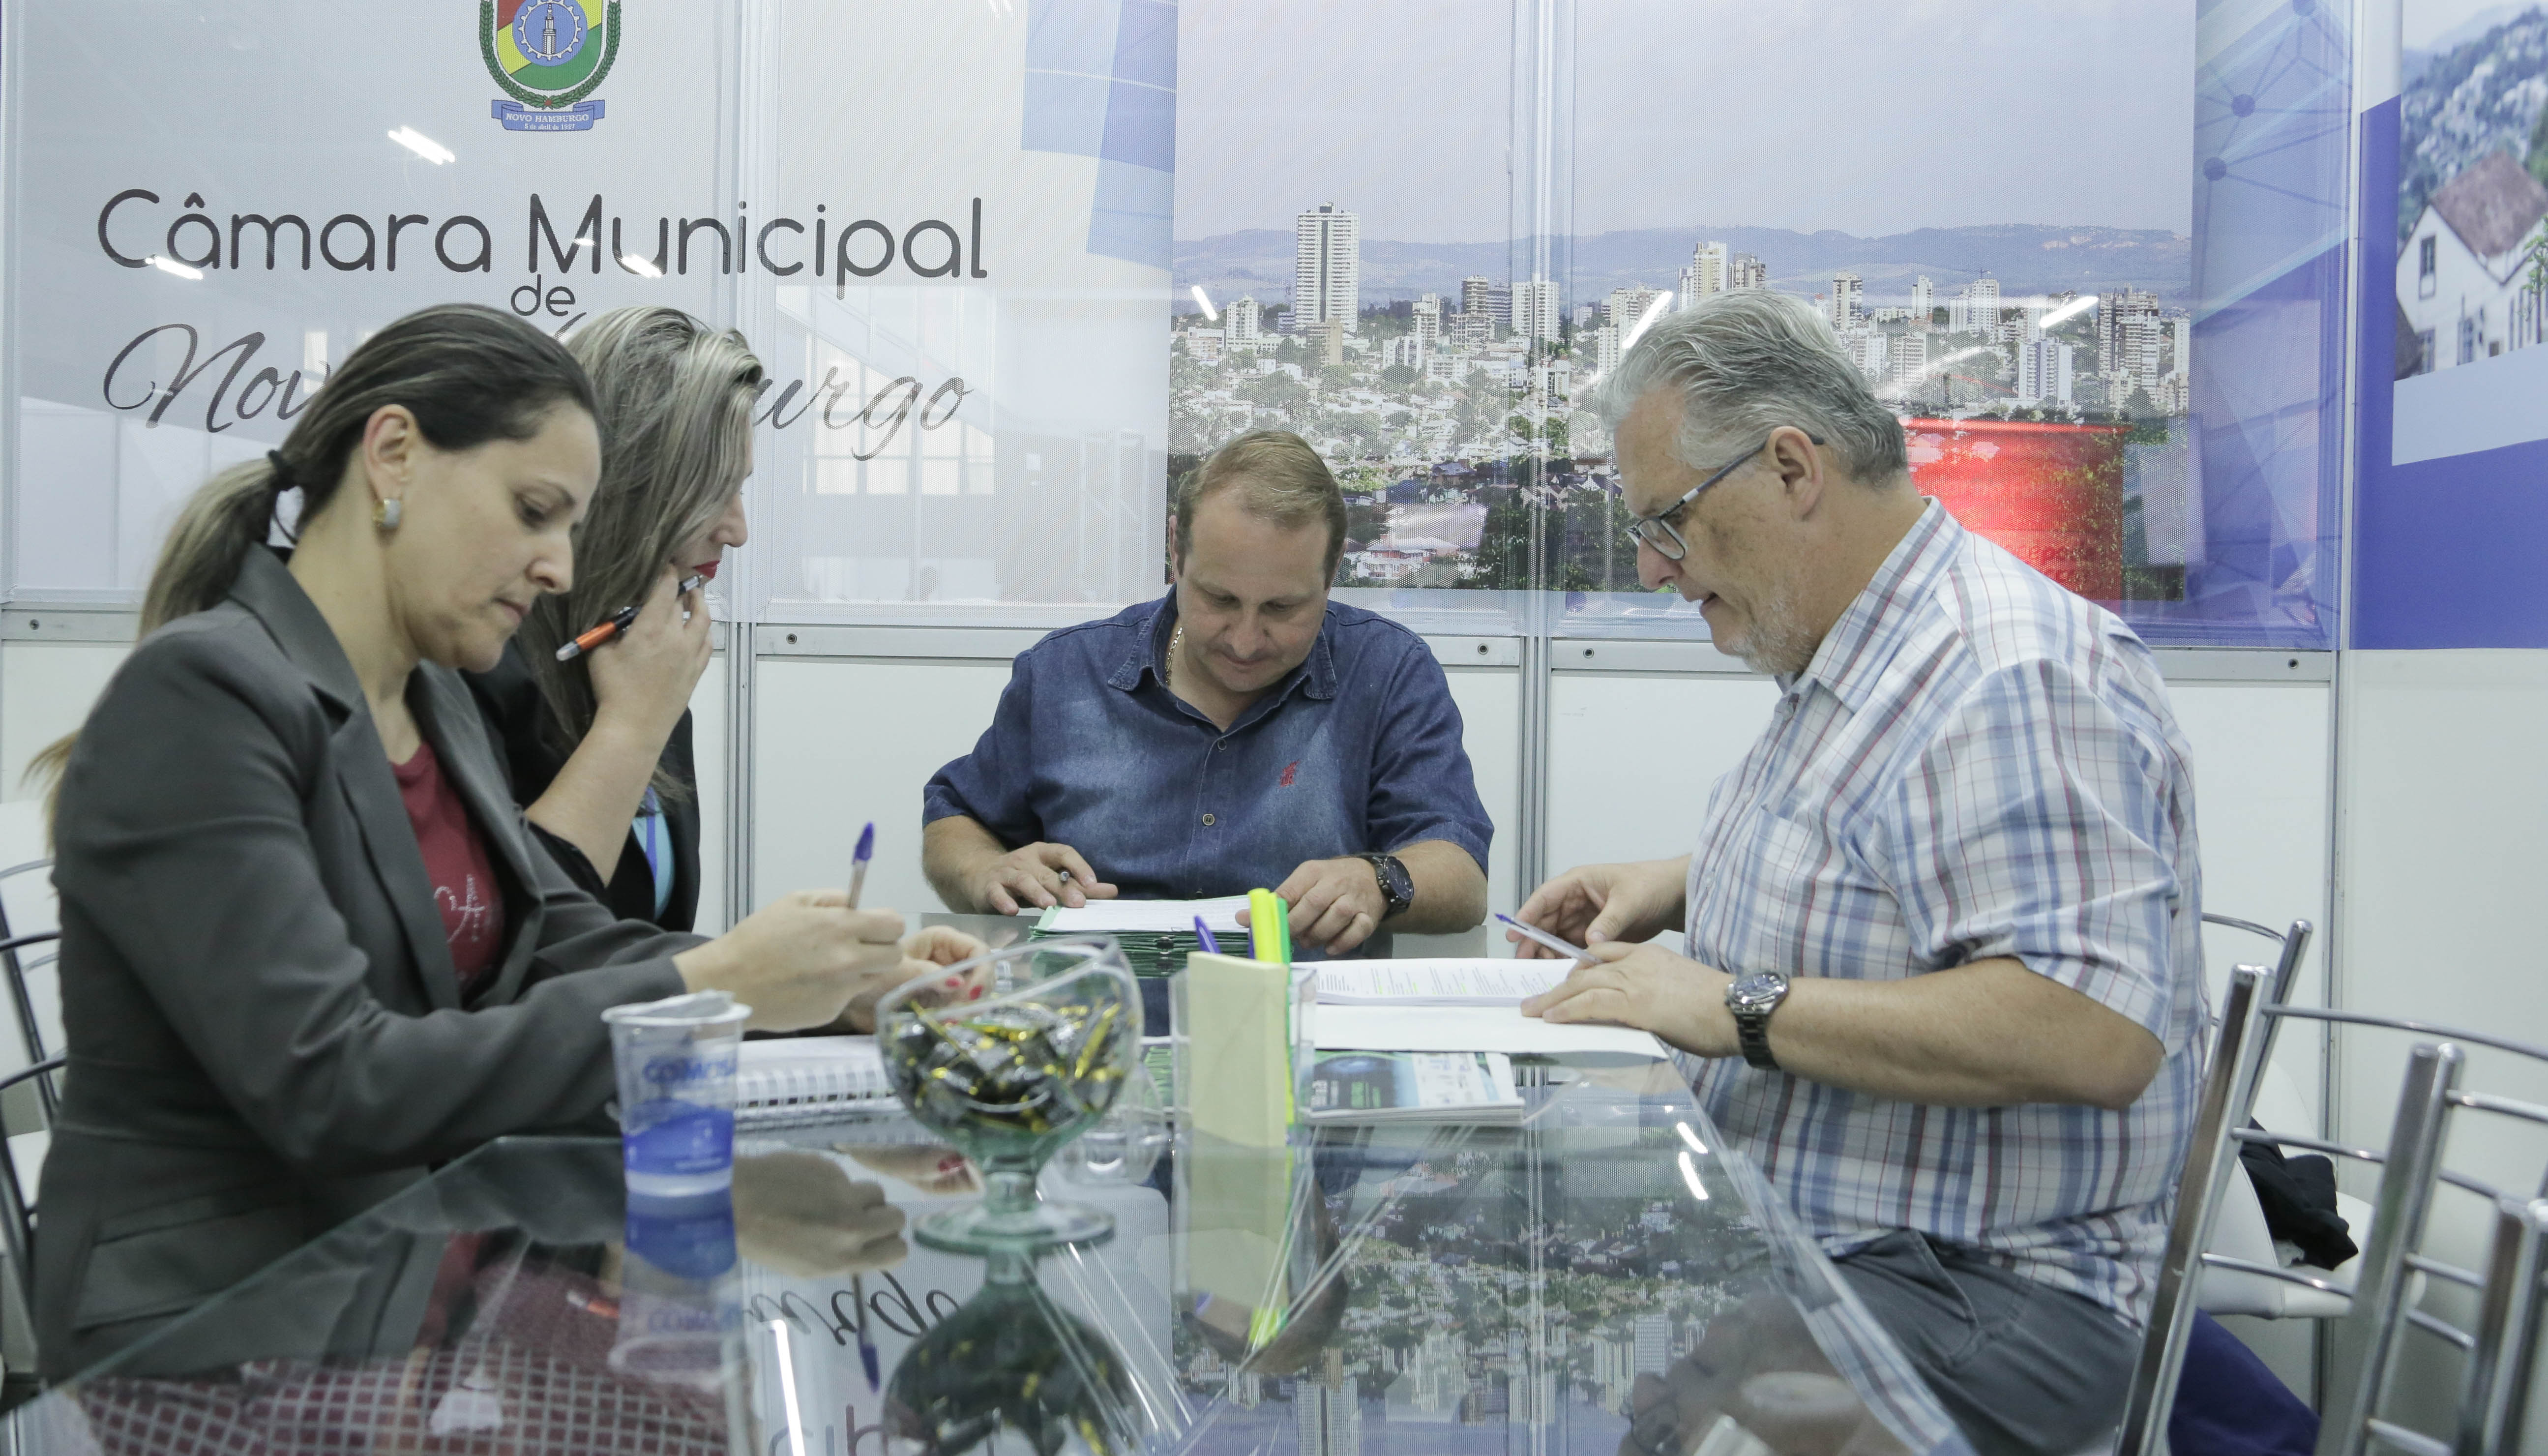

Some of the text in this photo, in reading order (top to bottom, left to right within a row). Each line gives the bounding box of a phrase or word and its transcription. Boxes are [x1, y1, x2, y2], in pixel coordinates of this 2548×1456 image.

[505, 113, 589, 122] NOVO HAMBURGO
[97, 188, 988, 300] Câmara Municipal
[510, 273, 576, 316] de
[103, 323, 331, 433] Nov
